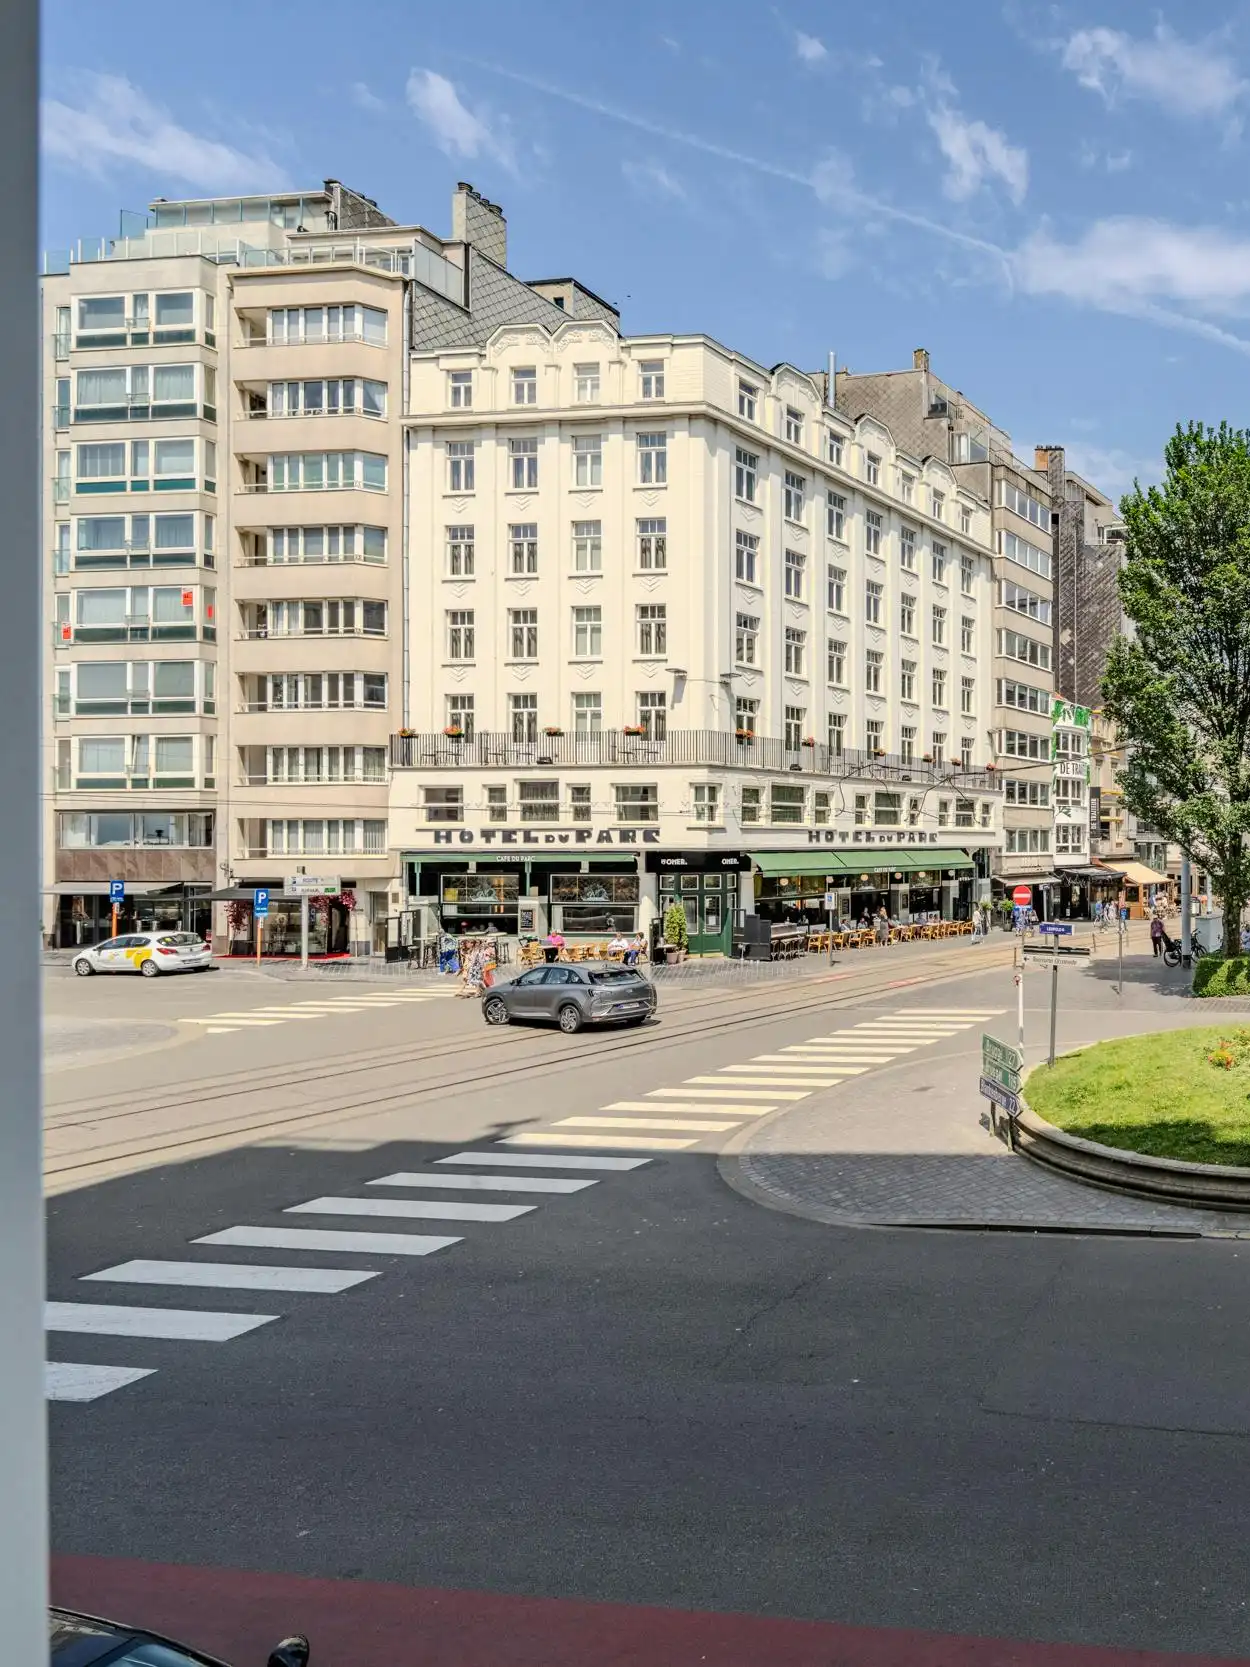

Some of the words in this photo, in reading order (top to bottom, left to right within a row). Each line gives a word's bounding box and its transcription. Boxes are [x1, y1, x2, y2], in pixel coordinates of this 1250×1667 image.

[1060, 762, 1071, 775] DE
[545, 834, 570, 843] DU
[576, 829, 660, 844] PARC
[112, 883, 123, 895] P
[258, 892, 267, 904] P
